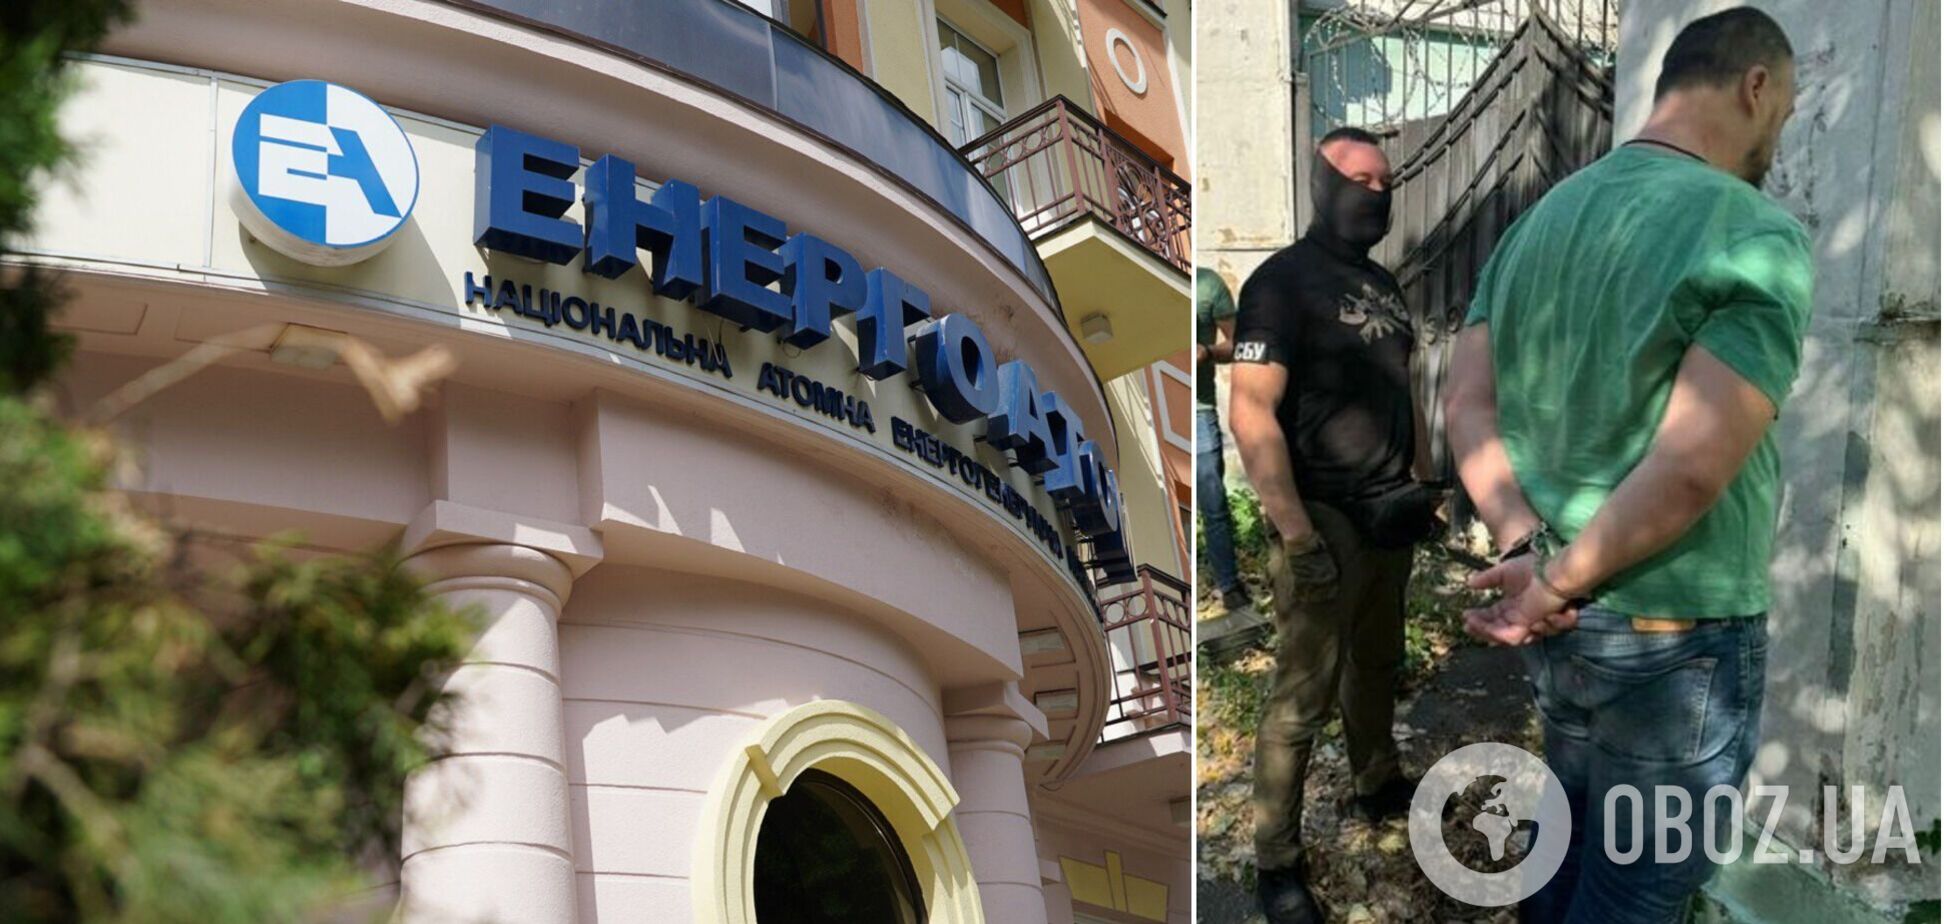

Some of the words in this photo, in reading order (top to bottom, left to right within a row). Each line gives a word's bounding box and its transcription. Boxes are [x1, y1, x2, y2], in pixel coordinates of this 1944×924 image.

[465, 271, 733, 379] НАЦІОНАЛЬНА
[757, 362, 876, 433] АТОМНА
[474, 124, 1137, 581] ЕНЕРГОАТО
[1233, 341, 1266, 361] СБУ
